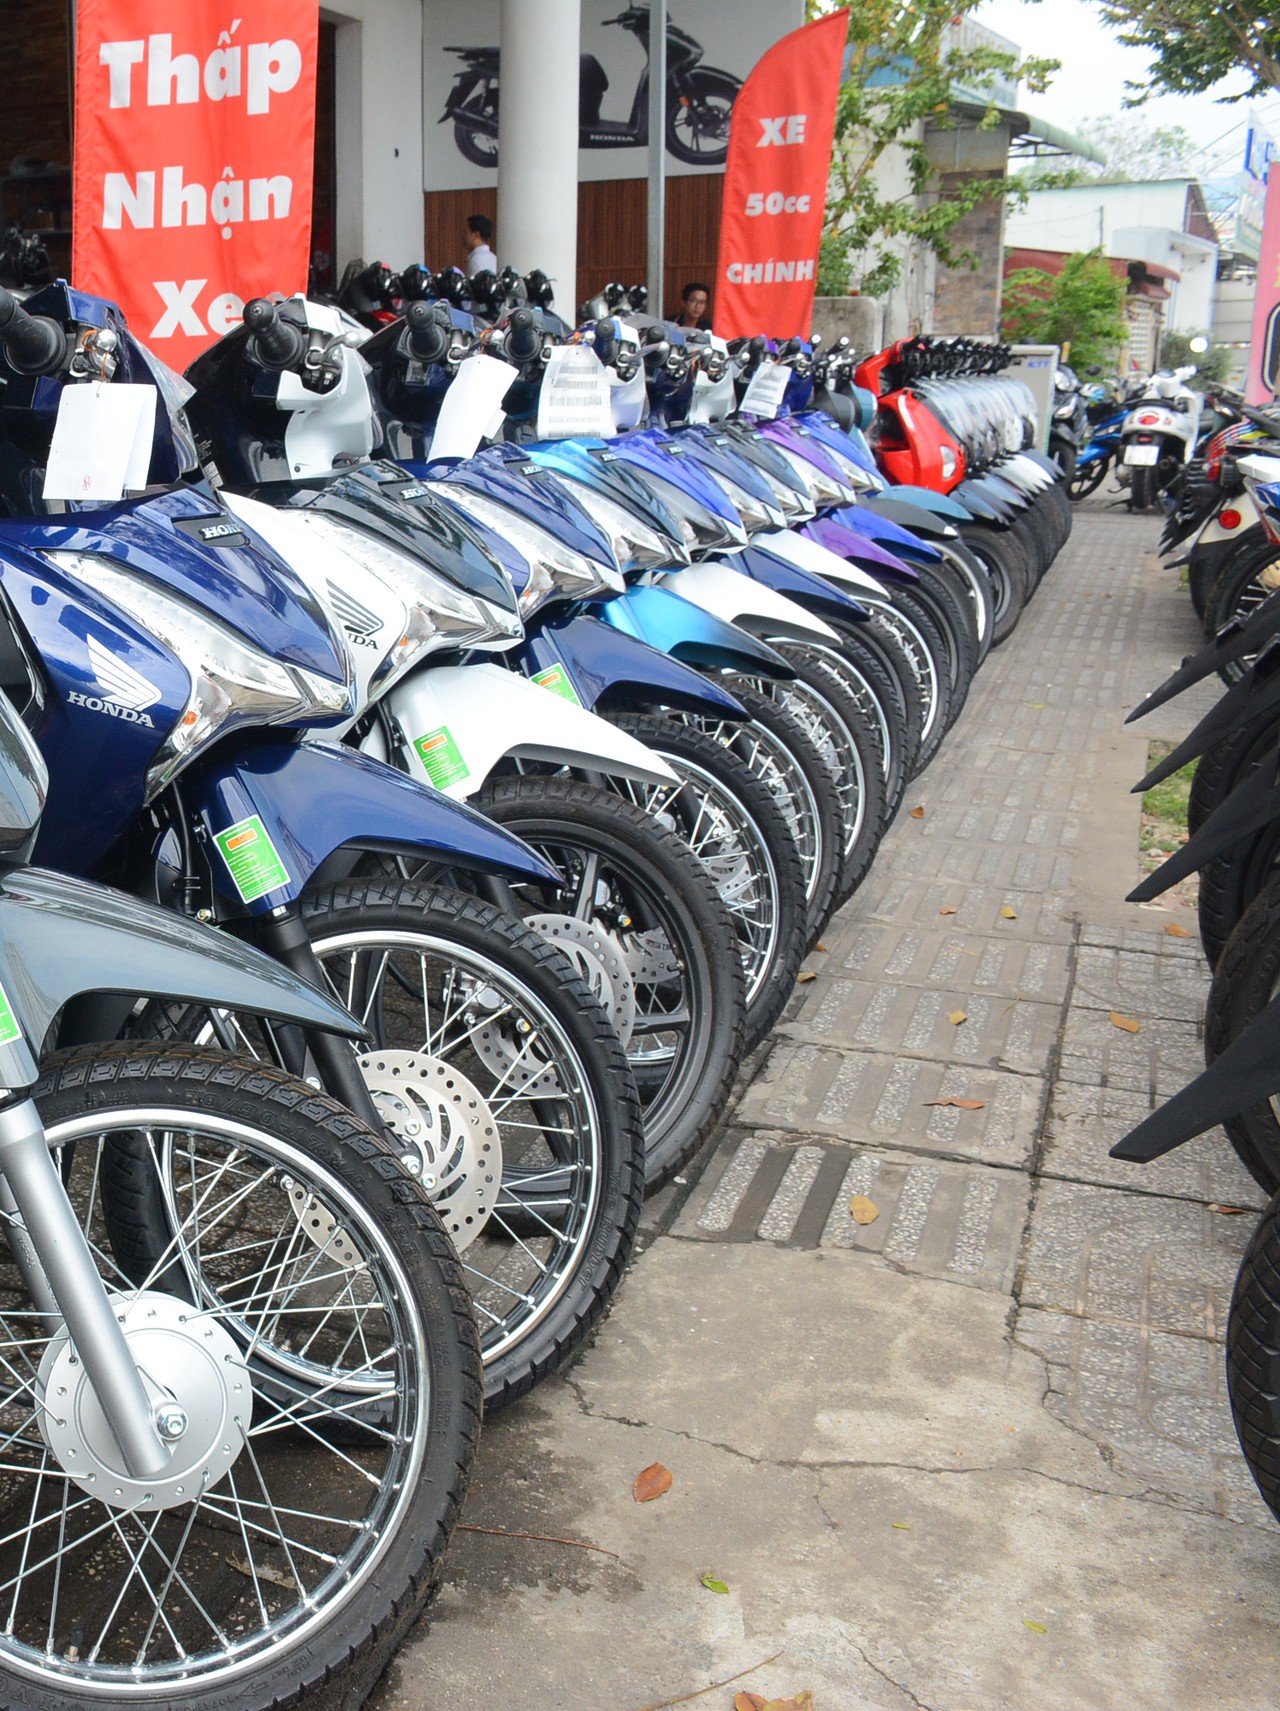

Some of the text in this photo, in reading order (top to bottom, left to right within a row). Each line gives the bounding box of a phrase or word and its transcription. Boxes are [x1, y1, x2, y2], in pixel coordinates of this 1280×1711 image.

[99, 19, 302, 115] Thấp
[756, 115, 807, 148] XE
[101, 165, 293, 240] Nhận
[745, 192, 811, 217] 50cc
[726, 253, 815, 286] CHÍNH
[66, 690, 156, 729] HONDA
[579, 1216, 613, 1291] Rubber
